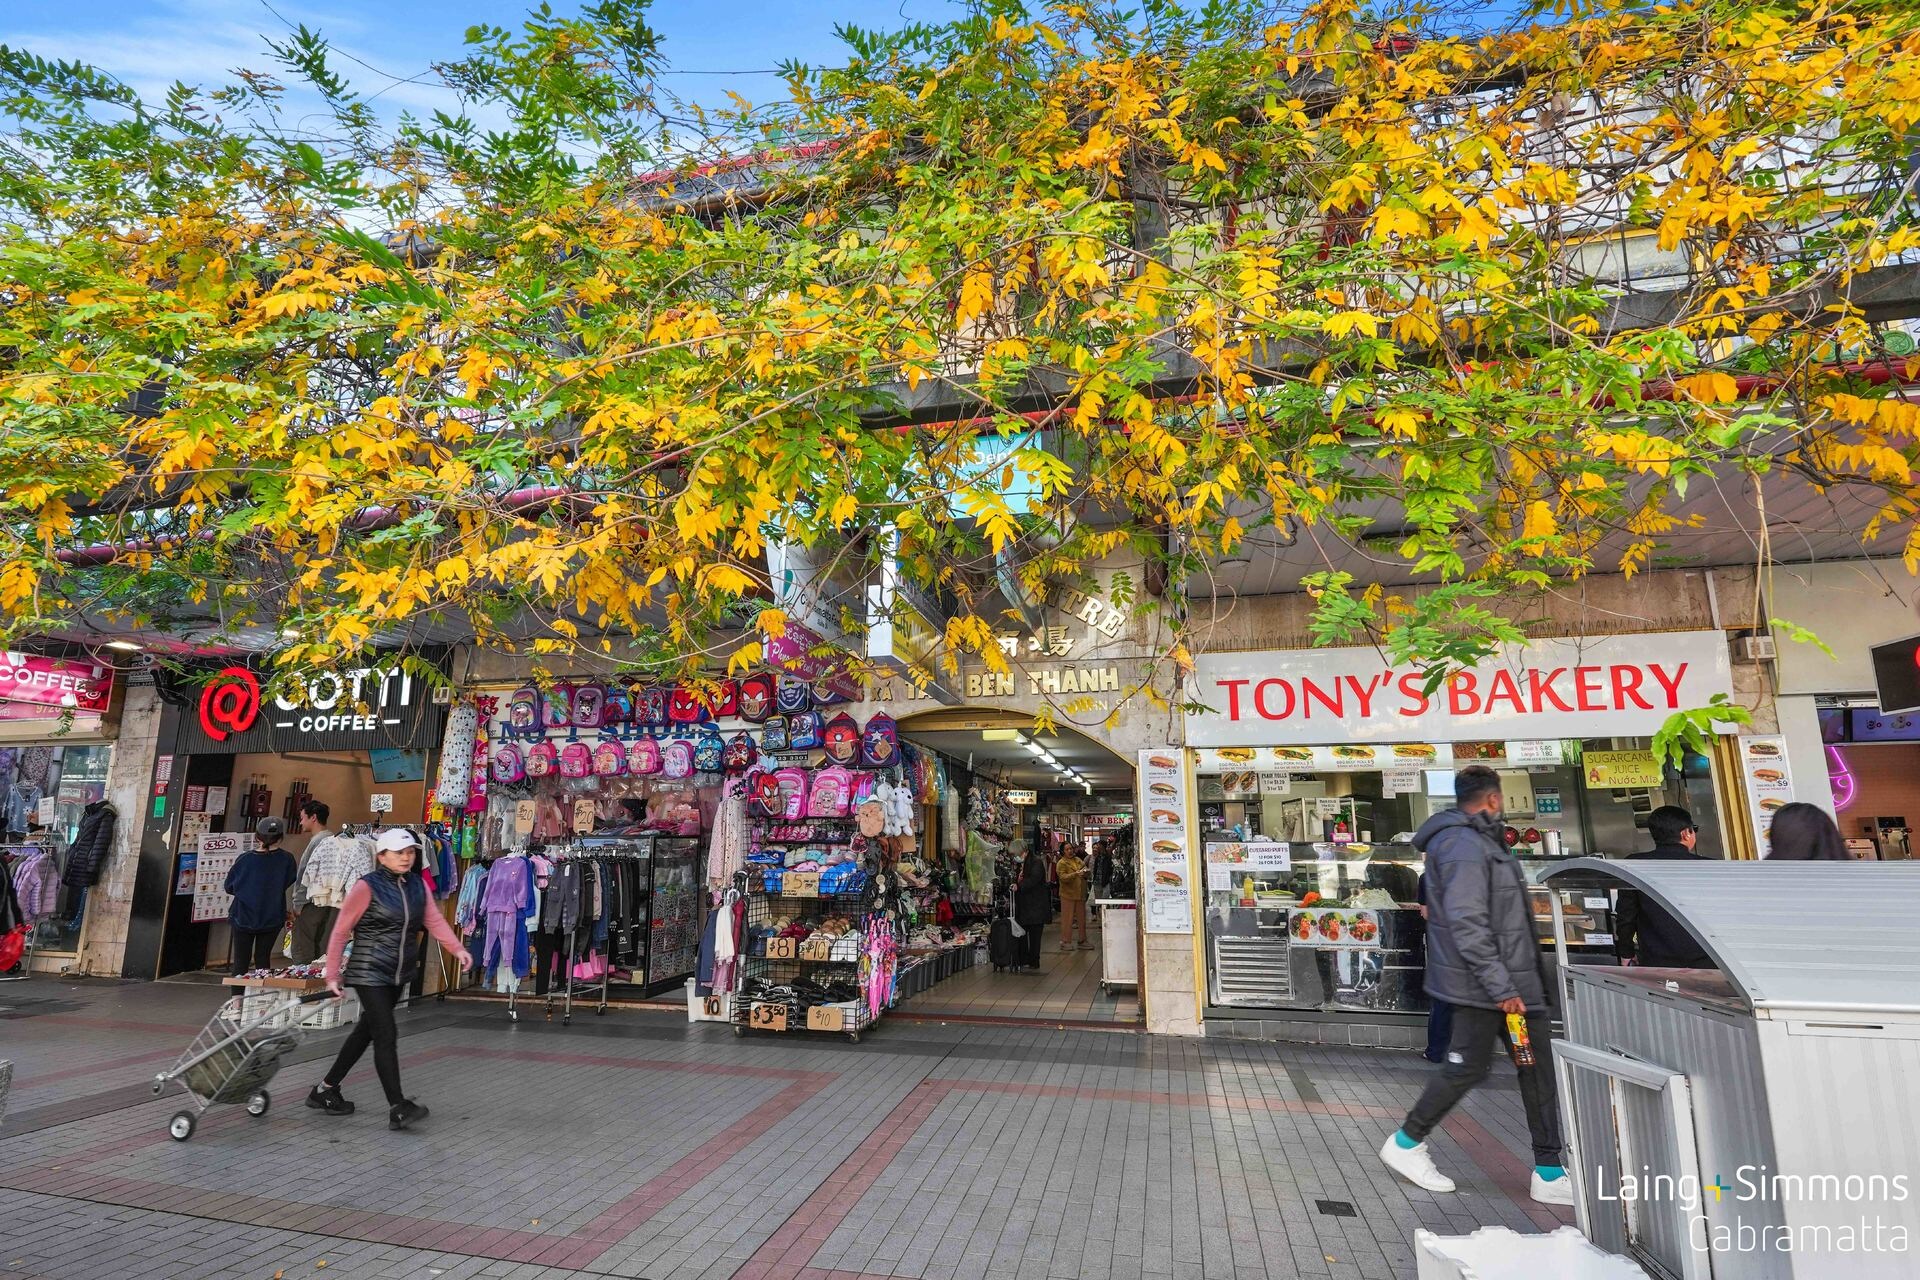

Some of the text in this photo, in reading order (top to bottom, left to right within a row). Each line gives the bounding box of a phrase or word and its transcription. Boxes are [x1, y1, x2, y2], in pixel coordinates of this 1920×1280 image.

[1027, 664, 1119, 696] THÀNH
[1216, 662, 1688, 721] TONY'S BAKERY
[299, 714, 377, 733] COFFEE
[1587, 752, 1654, 764] SUGARCANE
[1613, 764, 1641, 774] JUICE
[1777, 779, 1788, 787] $9
[575, 803, 594, 825] $20
[204, 838, 236, 851] $3.90
[769, 937, 790, 958] $8
[806, 940, 826, 960] $10
[815, 1009, 831, 1026] $10
